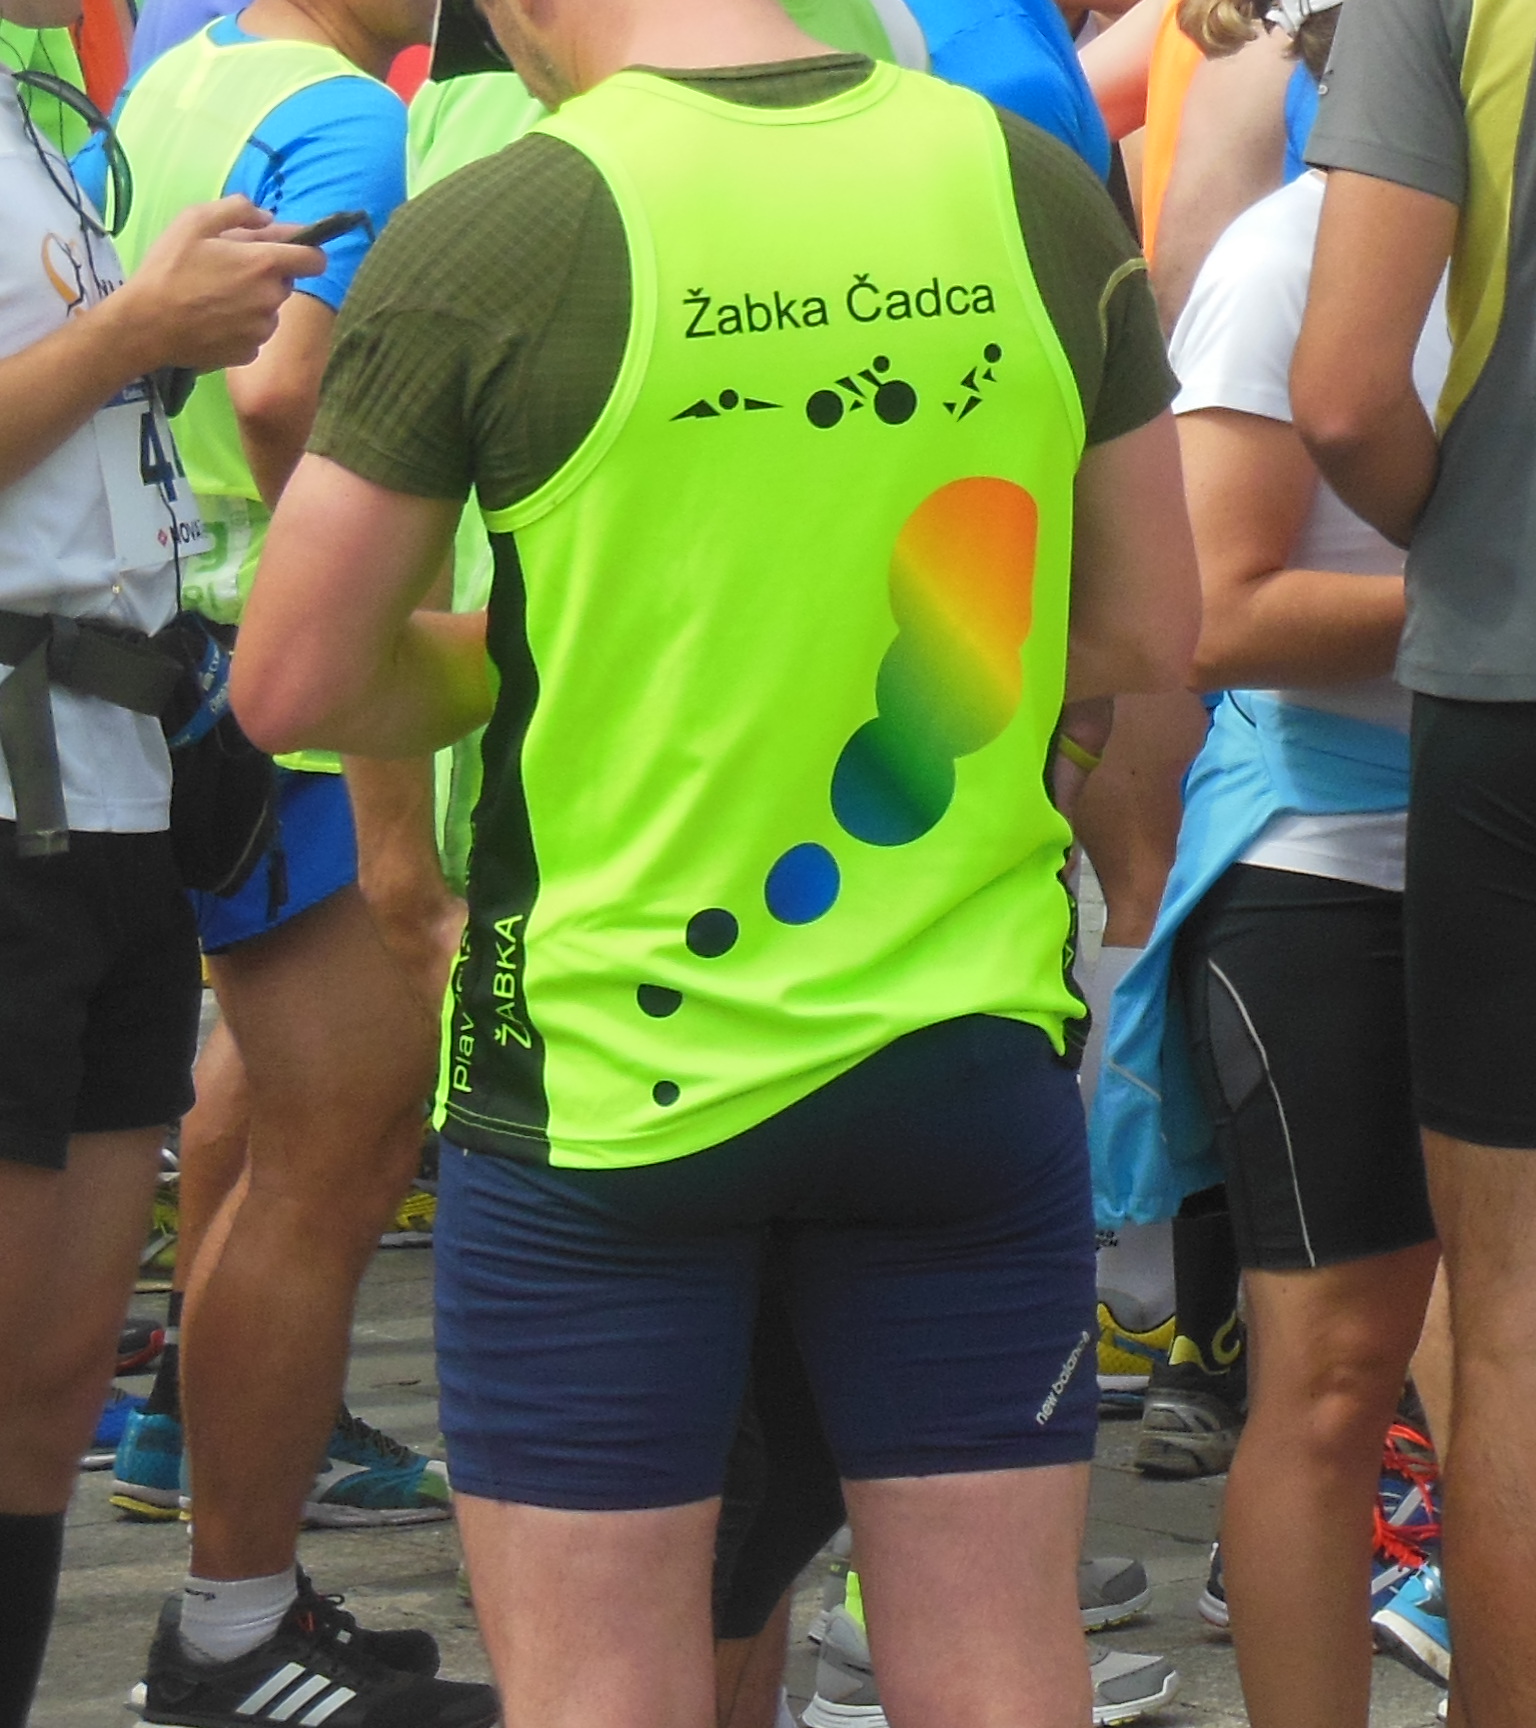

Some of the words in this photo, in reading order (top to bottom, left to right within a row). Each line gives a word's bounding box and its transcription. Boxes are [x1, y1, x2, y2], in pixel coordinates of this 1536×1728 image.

[682, 287, 830, 339] Žabka
[846, 273, 996, 323] Čadca
[493, 913, 533, 1050] ŽABKA
[1036, 1389, 1059, 1426] new
